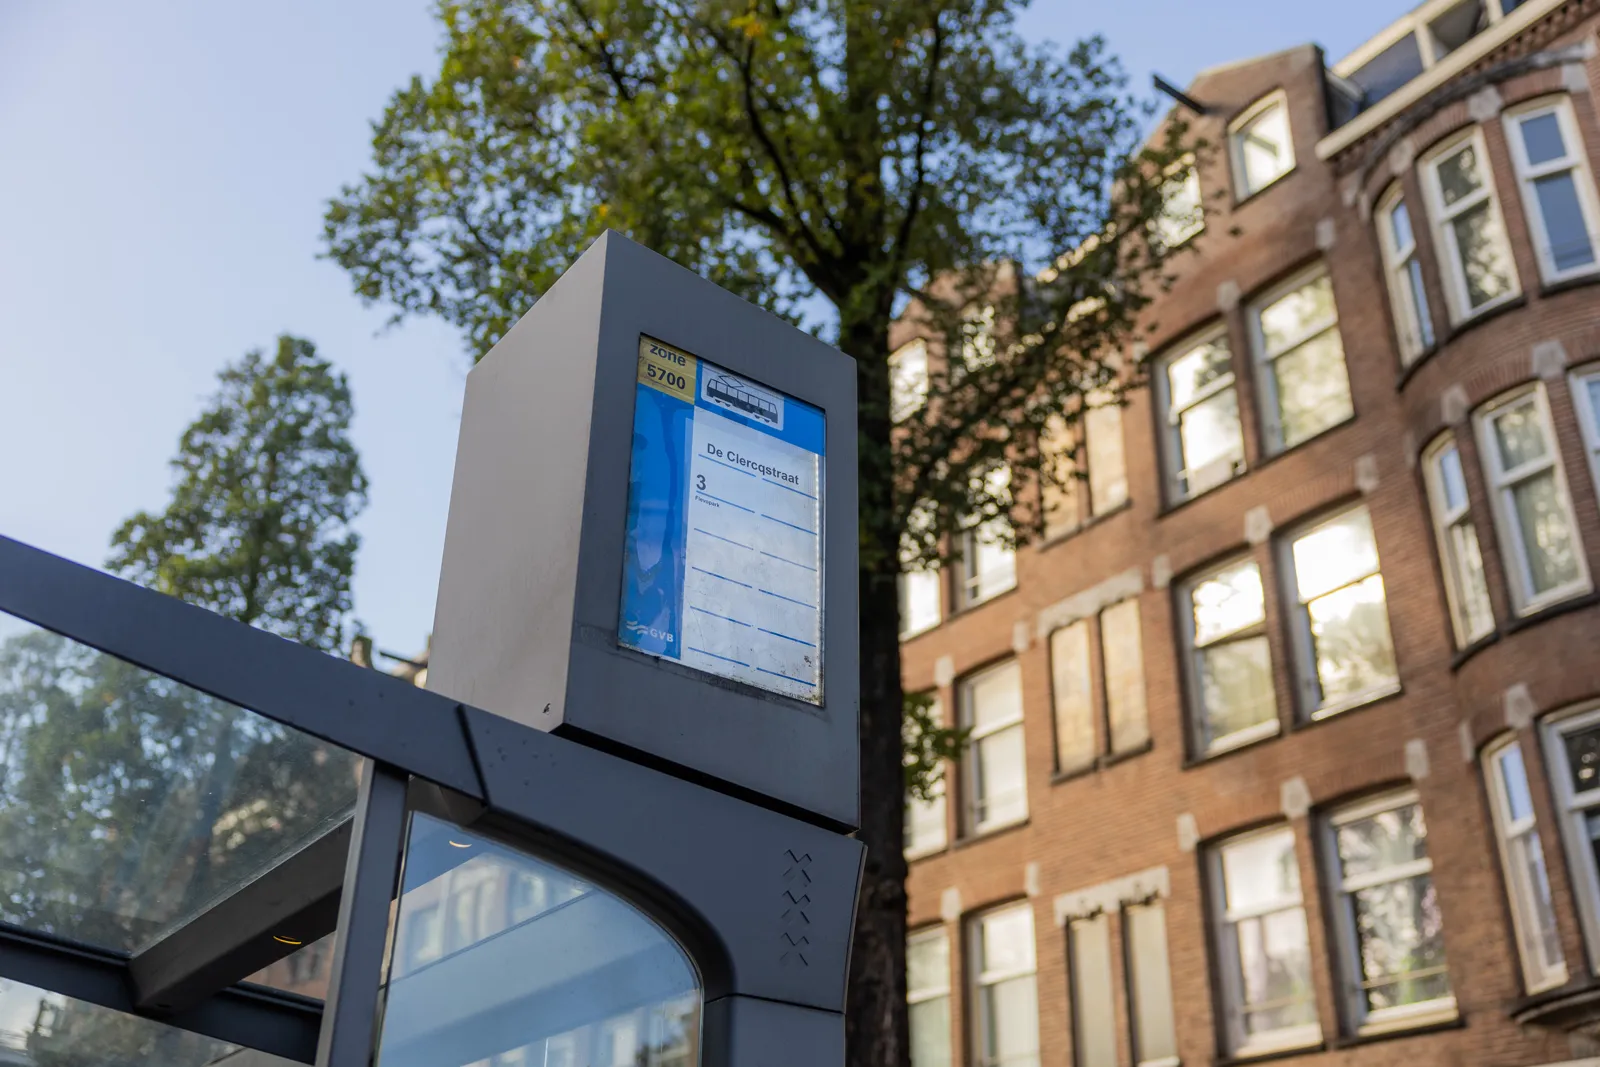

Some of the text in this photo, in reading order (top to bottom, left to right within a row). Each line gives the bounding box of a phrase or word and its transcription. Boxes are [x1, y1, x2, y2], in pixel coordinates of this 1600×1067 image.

[650, 343, 686, 366] zone
[647, 363, 686, 390] 5700
[707, 443, 799, 485] De Clercqstraat
[696, 474, 707, 491] 3
[650, 628, 674, 643] GVB
